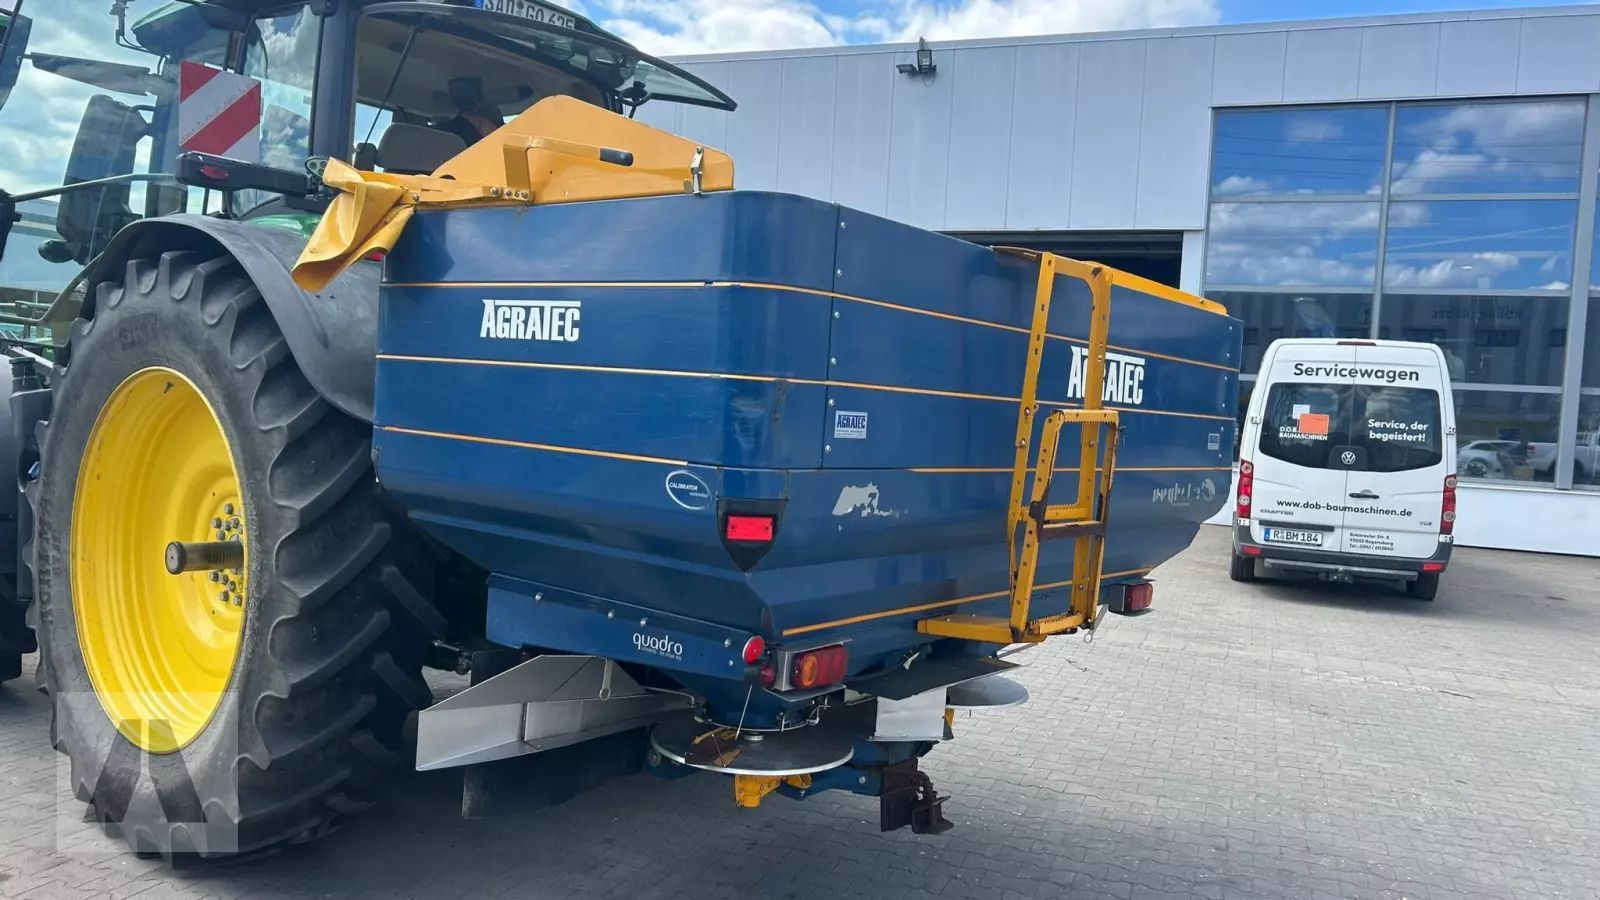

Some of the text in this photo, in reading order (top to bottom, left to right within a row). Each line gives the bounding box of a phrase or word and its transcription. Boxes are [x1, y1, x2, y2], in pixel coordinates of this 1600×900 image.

[480, 299, 581, 342] AGRATEC
[1067, 345, 1146, 405] AATEC
[1293, 363, 1420, 383] Servicewagen
[836, 414, 866, 429] AGRATEC
[1368, 419, 1429, 431] Service, der
[1279, 432, 1328, 441] BAUMASCHINEN
[1369, 430, 1426, 442] begeistert!
[1276, 500, 1412, 516] www.dob-baumaschinen.de
[1273, 530, 1318, 543] R BM 184
[633, 633, 683, 656] quadro
